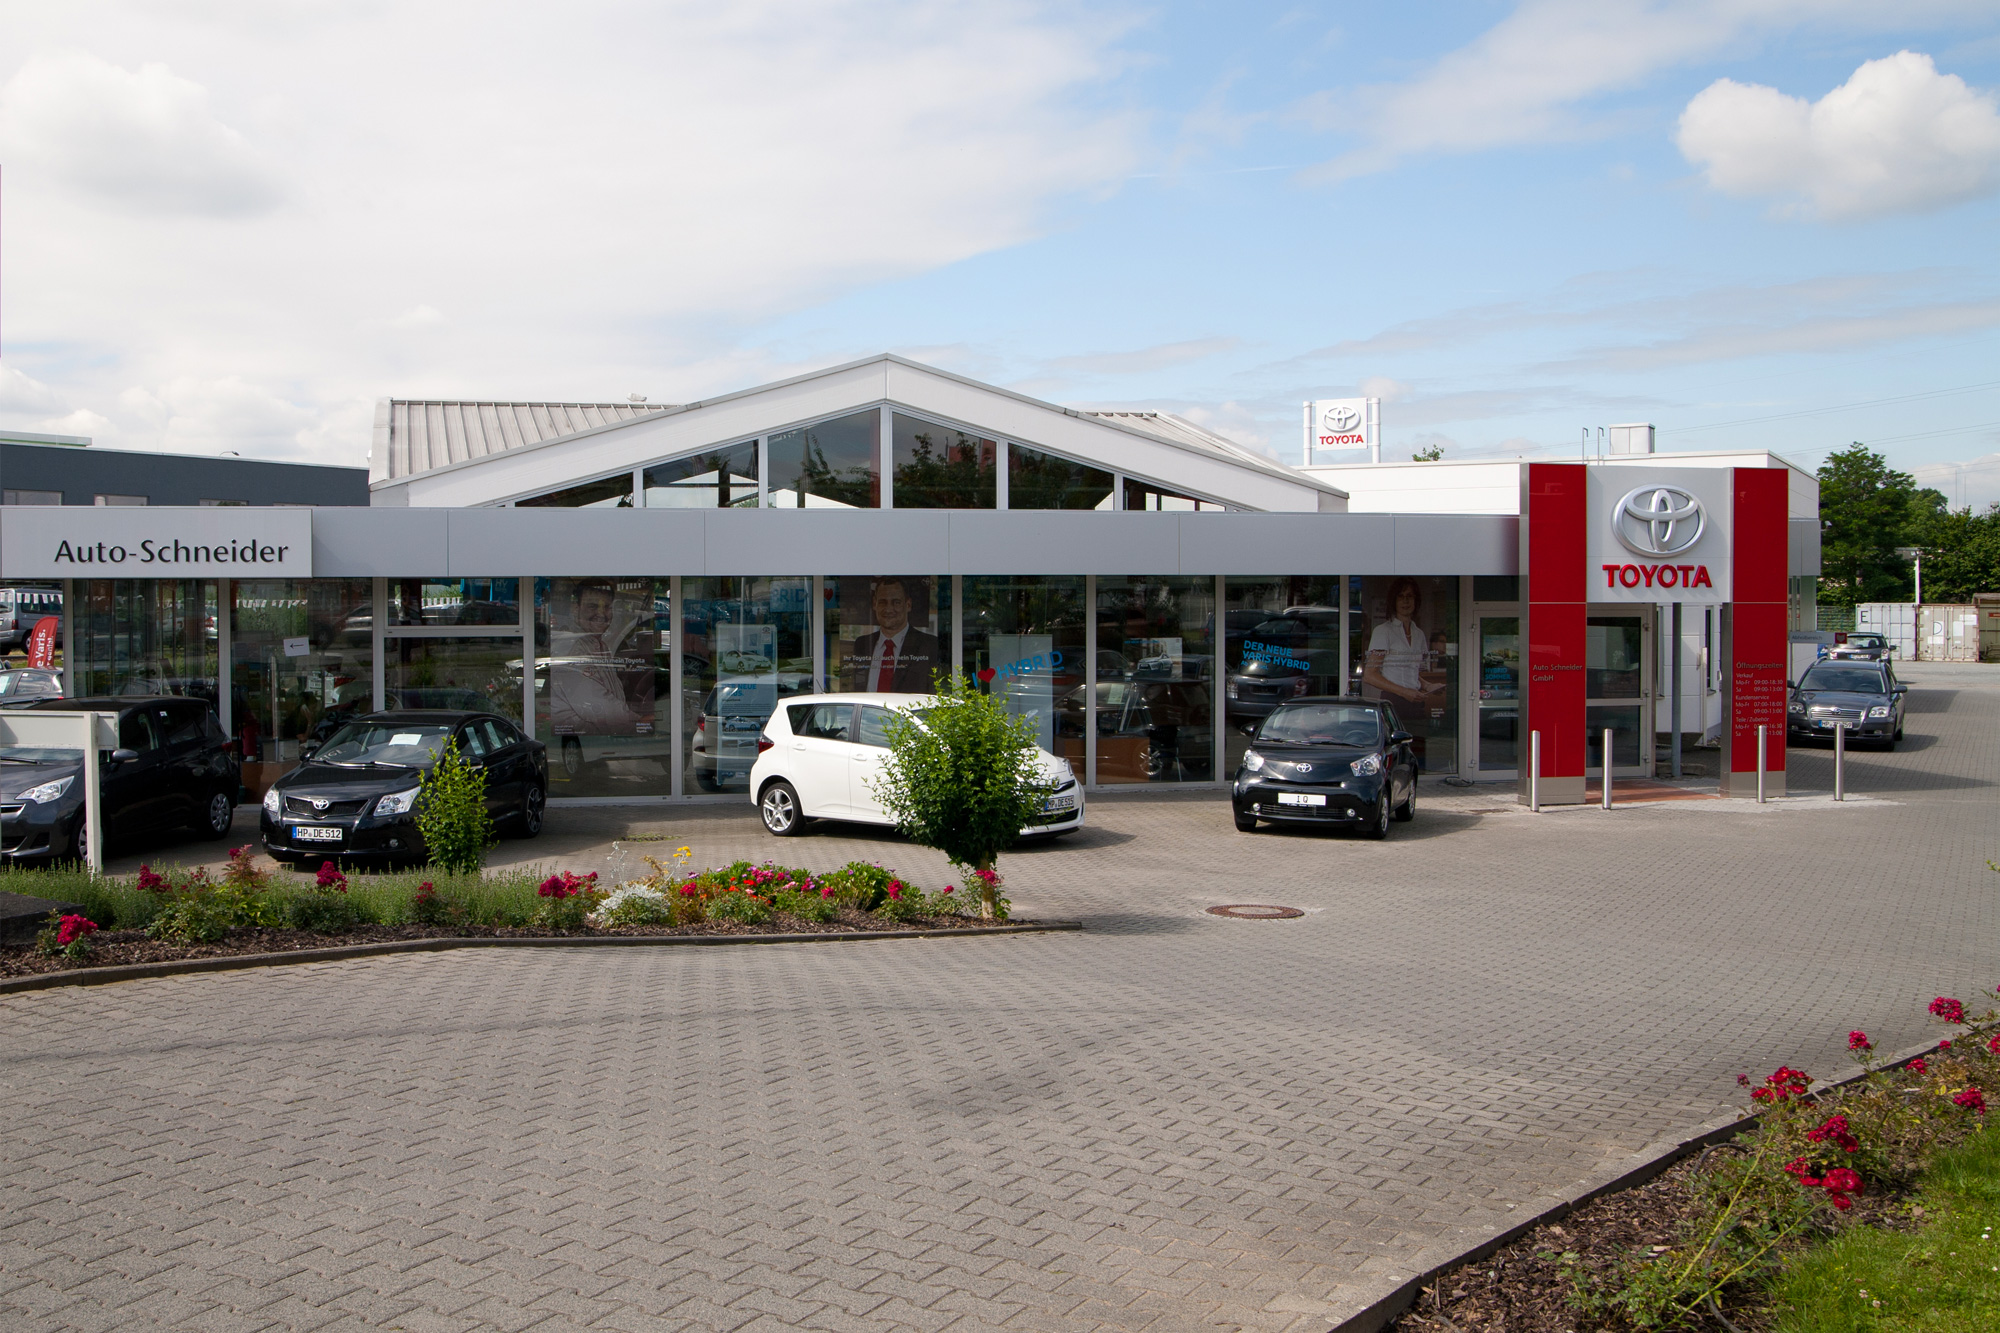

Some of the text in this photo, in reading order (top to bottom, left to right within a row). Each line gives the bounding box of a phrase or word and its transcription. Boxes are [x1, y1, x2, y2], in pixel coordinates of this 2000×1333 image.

[1319, 434, 1364, 445] TOYOTA
[54, 539, 289, 563] Auto-Schneider
[1602, 564, 1712, 588] TOYOTA
[1861, 610, 1869, 623] E
[1243, 640, 1293, 657] DER NEUE
[625, 657, 645, 665] Toyota
[996, 650, 1063, 680] HYBRID
[1273, 656, 1310, 671] HYBRID
[1736, 662, 1783, 670] Öffnungszeiten
[297, 829, 341, 839] HP DE 512
